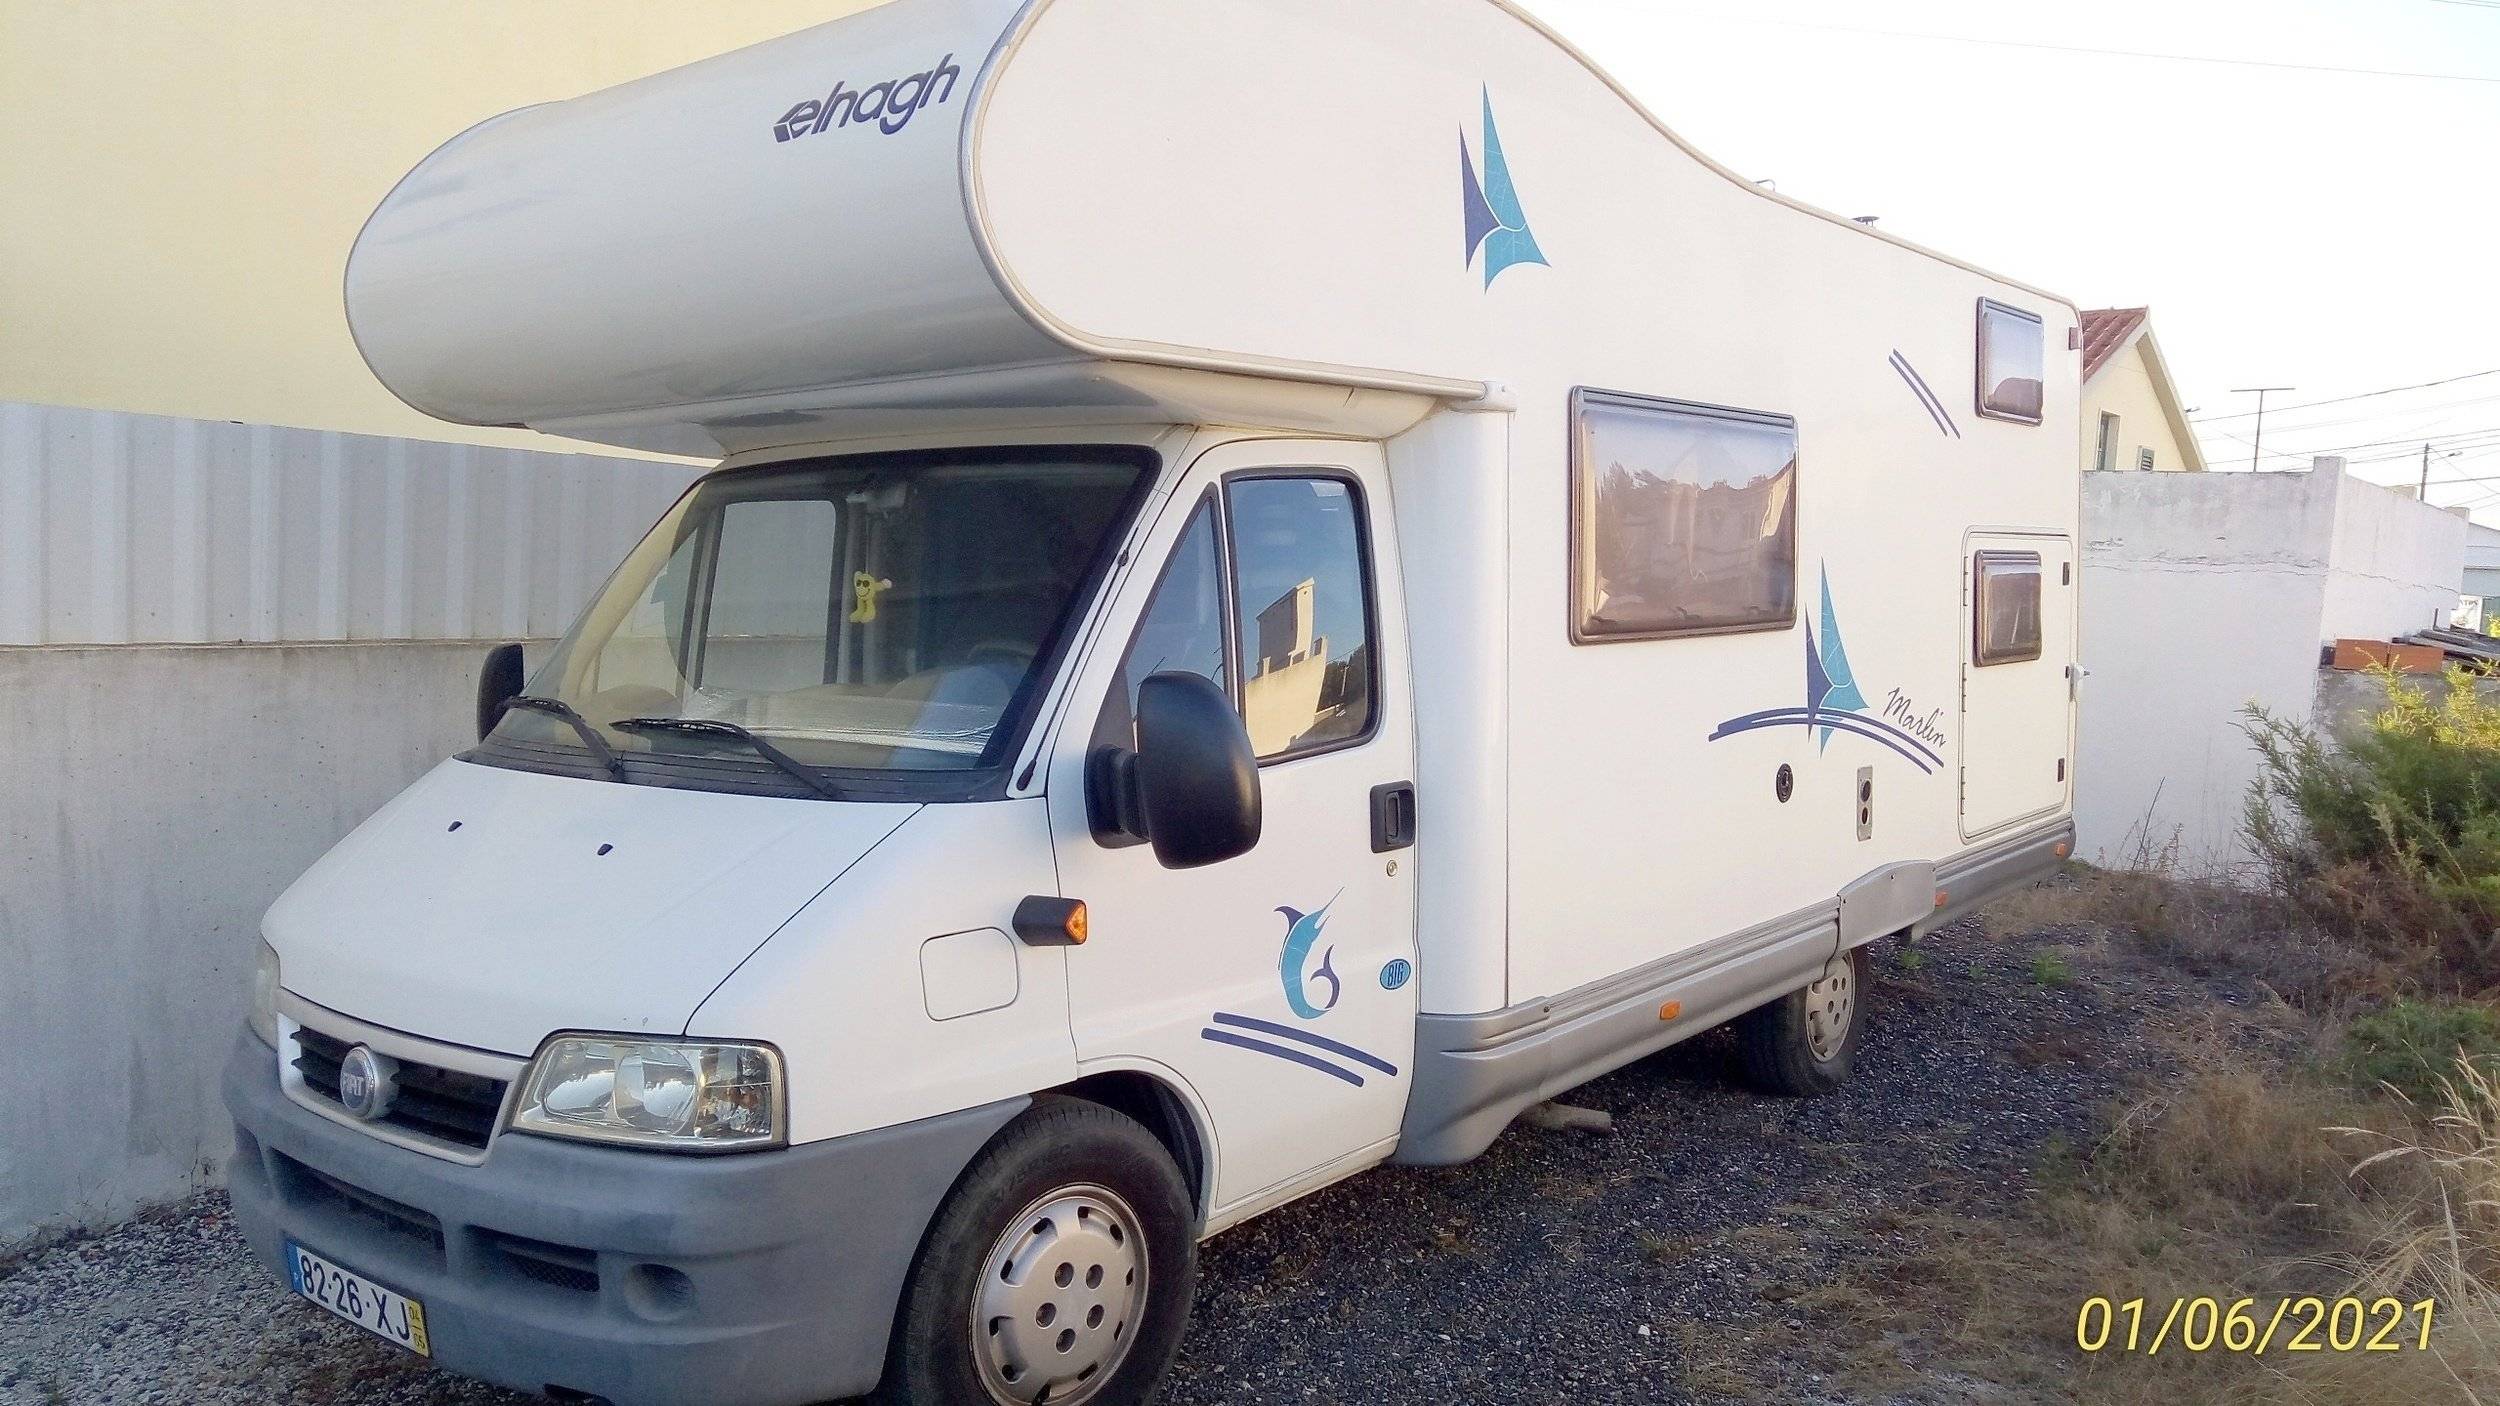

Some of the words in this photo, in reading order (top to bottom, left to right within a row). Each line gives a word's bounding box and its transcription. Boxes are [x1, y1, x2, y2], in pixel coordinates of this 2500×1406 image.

[775, 53, 961, 143] elnagh
[1883, 687, 1946, 748] Marlin
[1387, 962, 1404, 987] BIG
